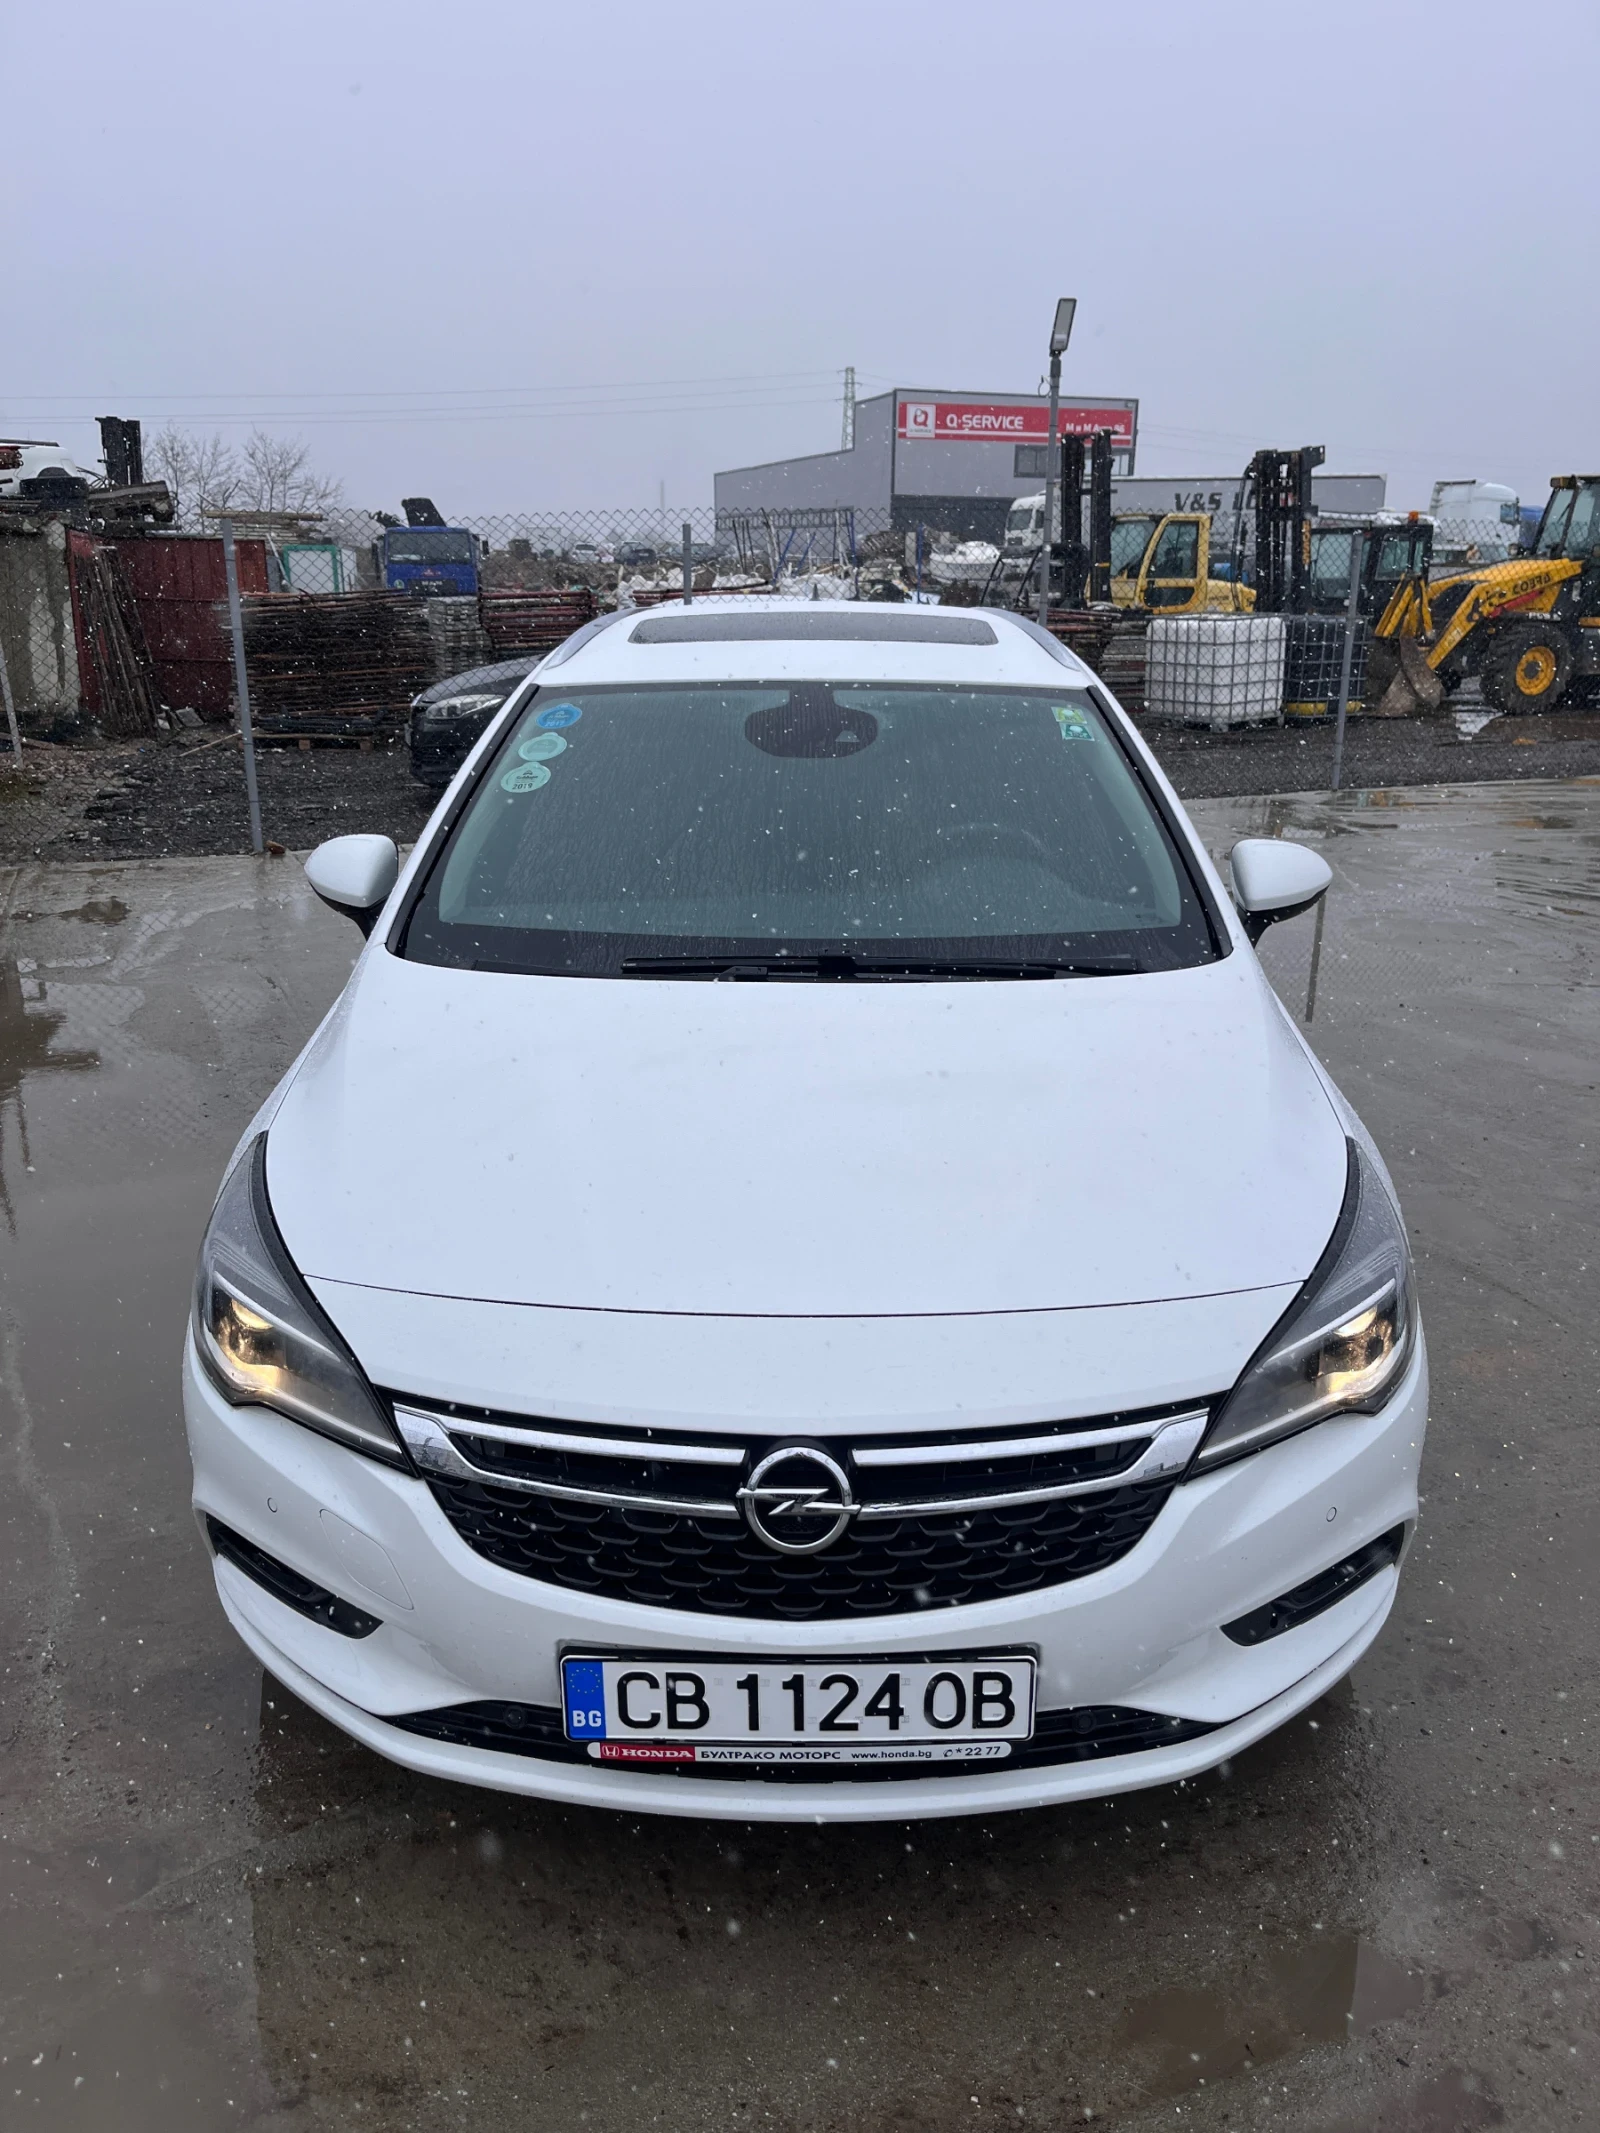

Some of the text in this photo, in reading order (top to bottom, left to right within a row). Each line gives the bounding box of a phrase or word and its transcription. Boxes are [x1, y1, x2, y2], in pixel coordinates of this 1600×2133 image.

[1174, 492, 1223, 511] V&S
[512, 782, 533, 790] 2019
[617, 1671, 1016, 1731] CB 1124 OB
[572, 1710, 602, 1727] BG
[621, 1748, 694, 1758] HONDA
[700, 1751, 841, 1760] БУЛТРАКО МОТОРС
[851, 1748, 932, 1759] www.honda.bg
